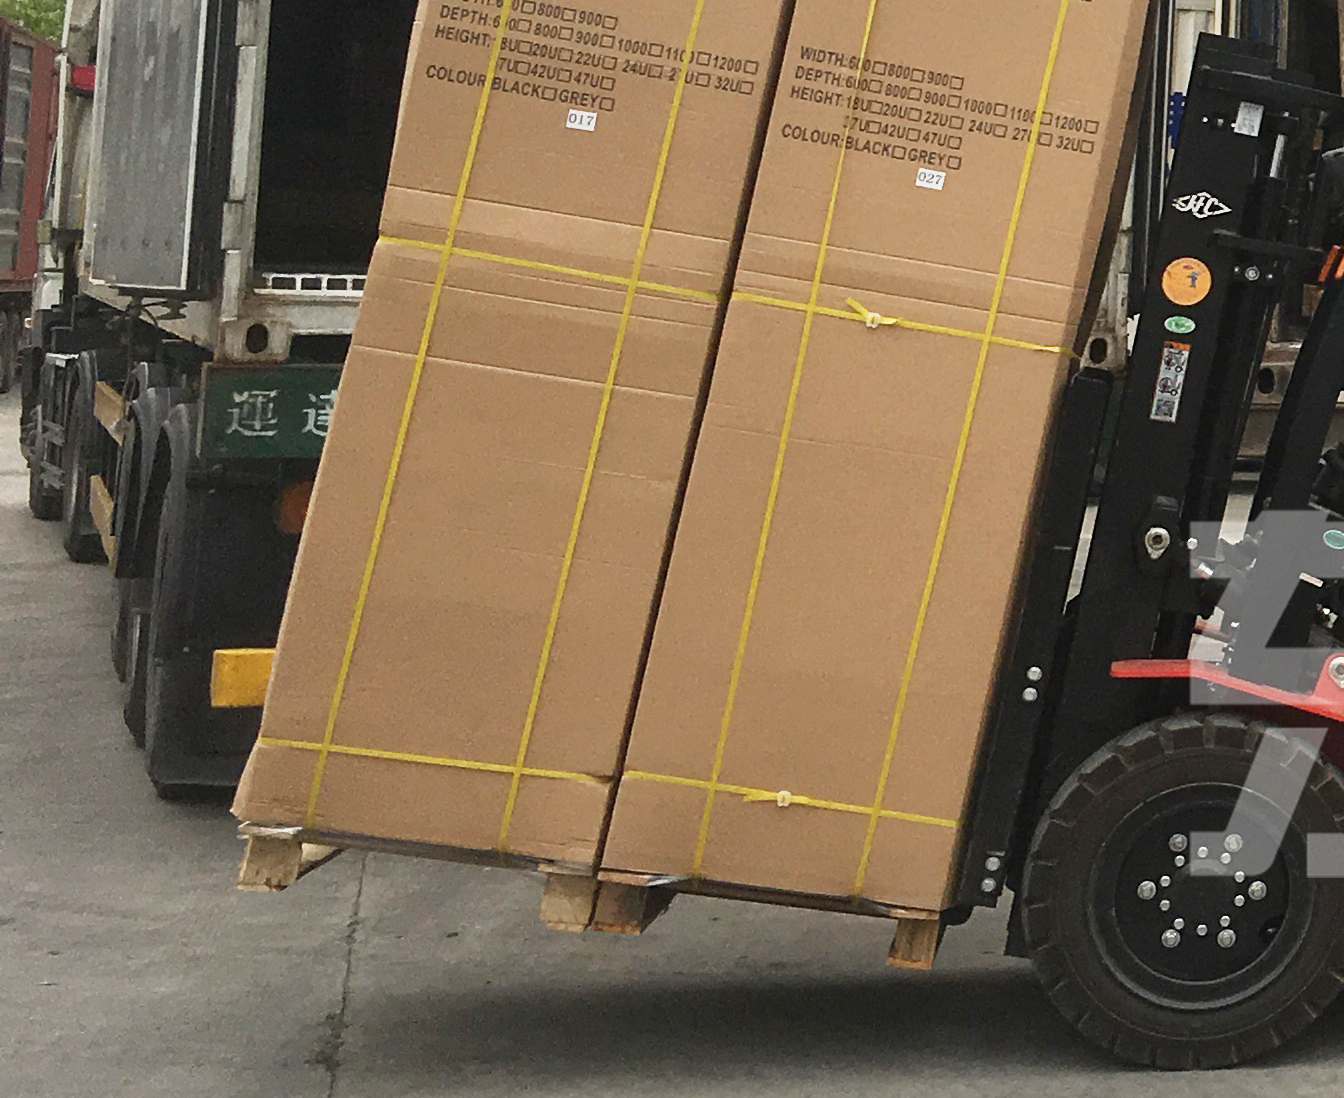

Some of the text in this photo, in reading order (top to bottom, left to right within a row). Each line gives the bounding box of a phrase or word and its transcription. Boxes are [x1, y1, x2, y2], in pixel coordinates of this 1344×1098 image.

[440, 5, 517, 31] DEPTH:60
[617, 39, 648, 55] 1000
[713, 55, 742, 72] 1200
[530, 65, 558, 80] 42U
[574, 72, 600, 88] 47U
[575, 52, 601, 67] 22U
[667, 67, 695, 84] 2U
[714, 76, 740, 92] 32U
[927, 71, 949, 86] 900
[558, 89, 599, 108] GREY
[568, 113, 595, 127] 017
[924, 91, 947, 106] 900
[963, 98, 993, 115] 1000
[1054, 115, 1082, 132] 1200
[881, 122, 906, 138] 42U
[922, 131, 948, 147] 47U
[924, 111, 949, 127] 22U
[968, 120, 993, 135] 24U
[1056, 135, 1081, 152] 32U
[908, 148, 948, 167] GREY
[918, 171, 943, 185] 027
